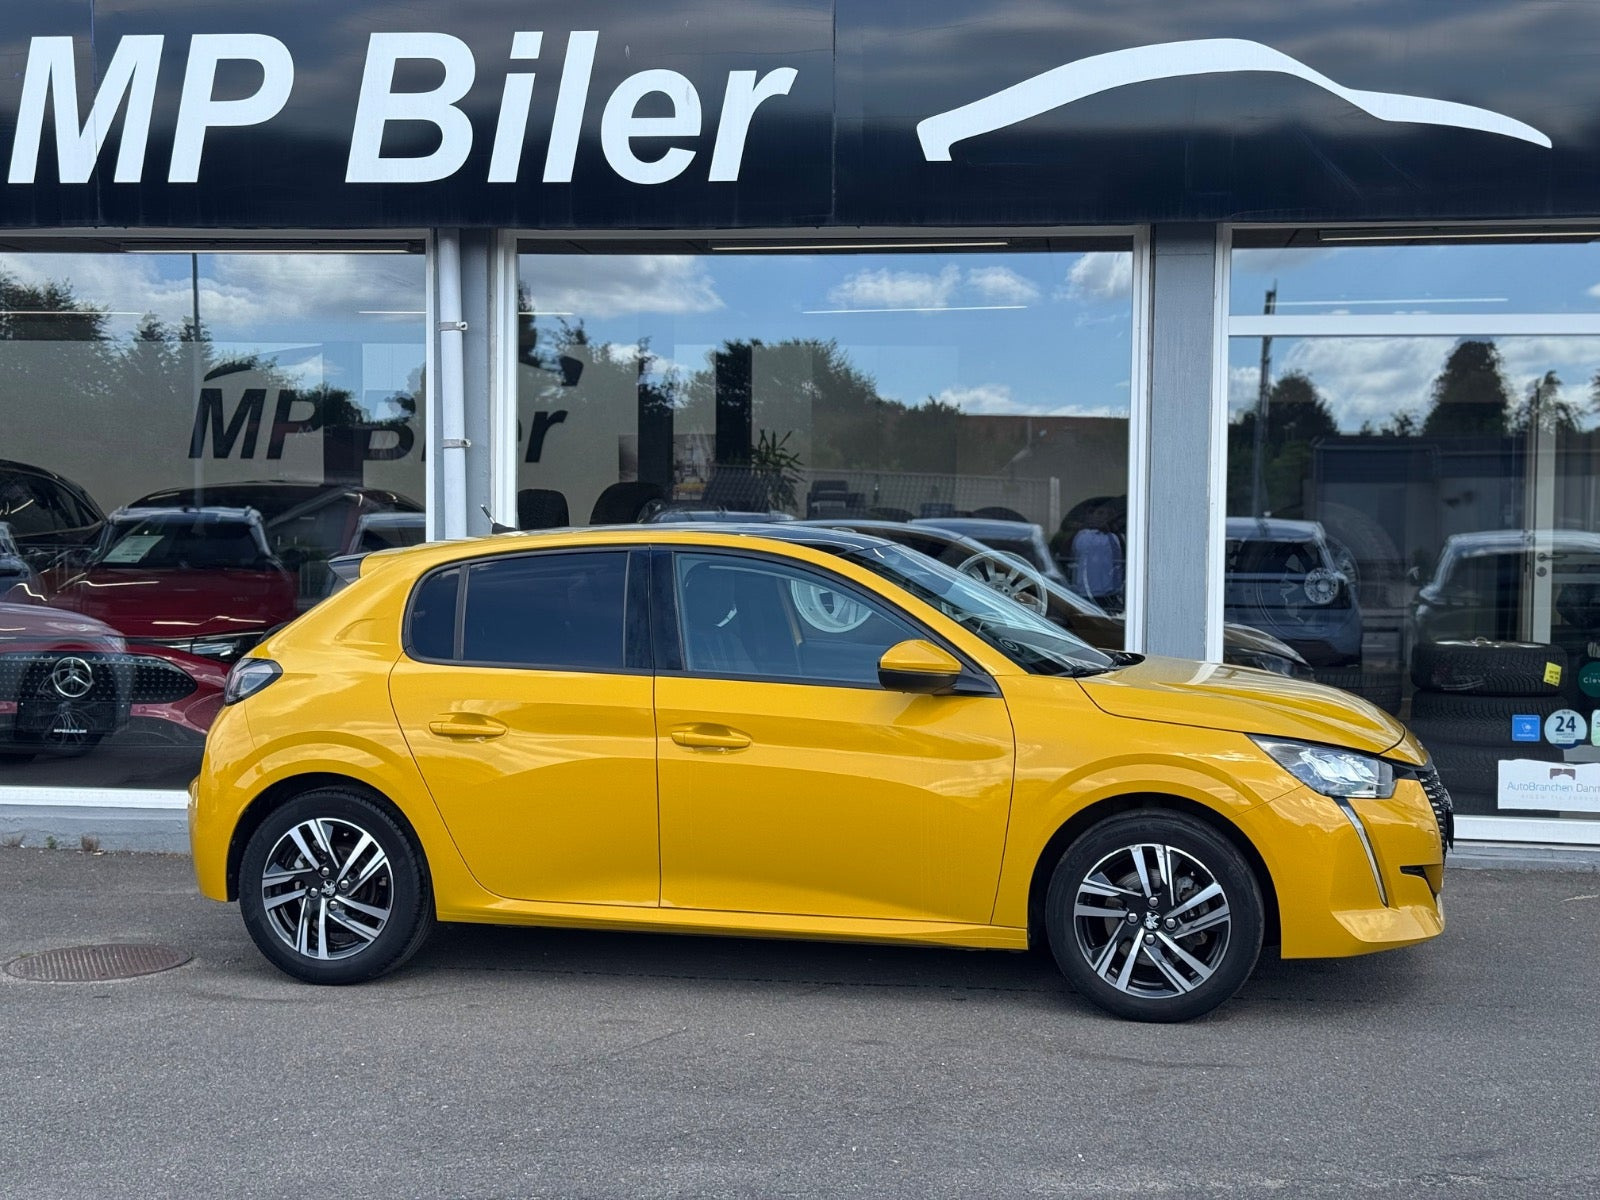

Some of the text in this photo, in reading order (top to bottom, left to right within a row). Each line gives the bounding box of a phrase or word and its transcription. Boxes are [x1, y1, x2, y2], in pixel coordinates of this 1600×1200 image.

[7, 30, 798, 184] MP Biler
[187, 387, 321, 460] MP
[1555, 716, 1576, 732] 24
[1506, 781, 1573, 792] AutoBranchen
